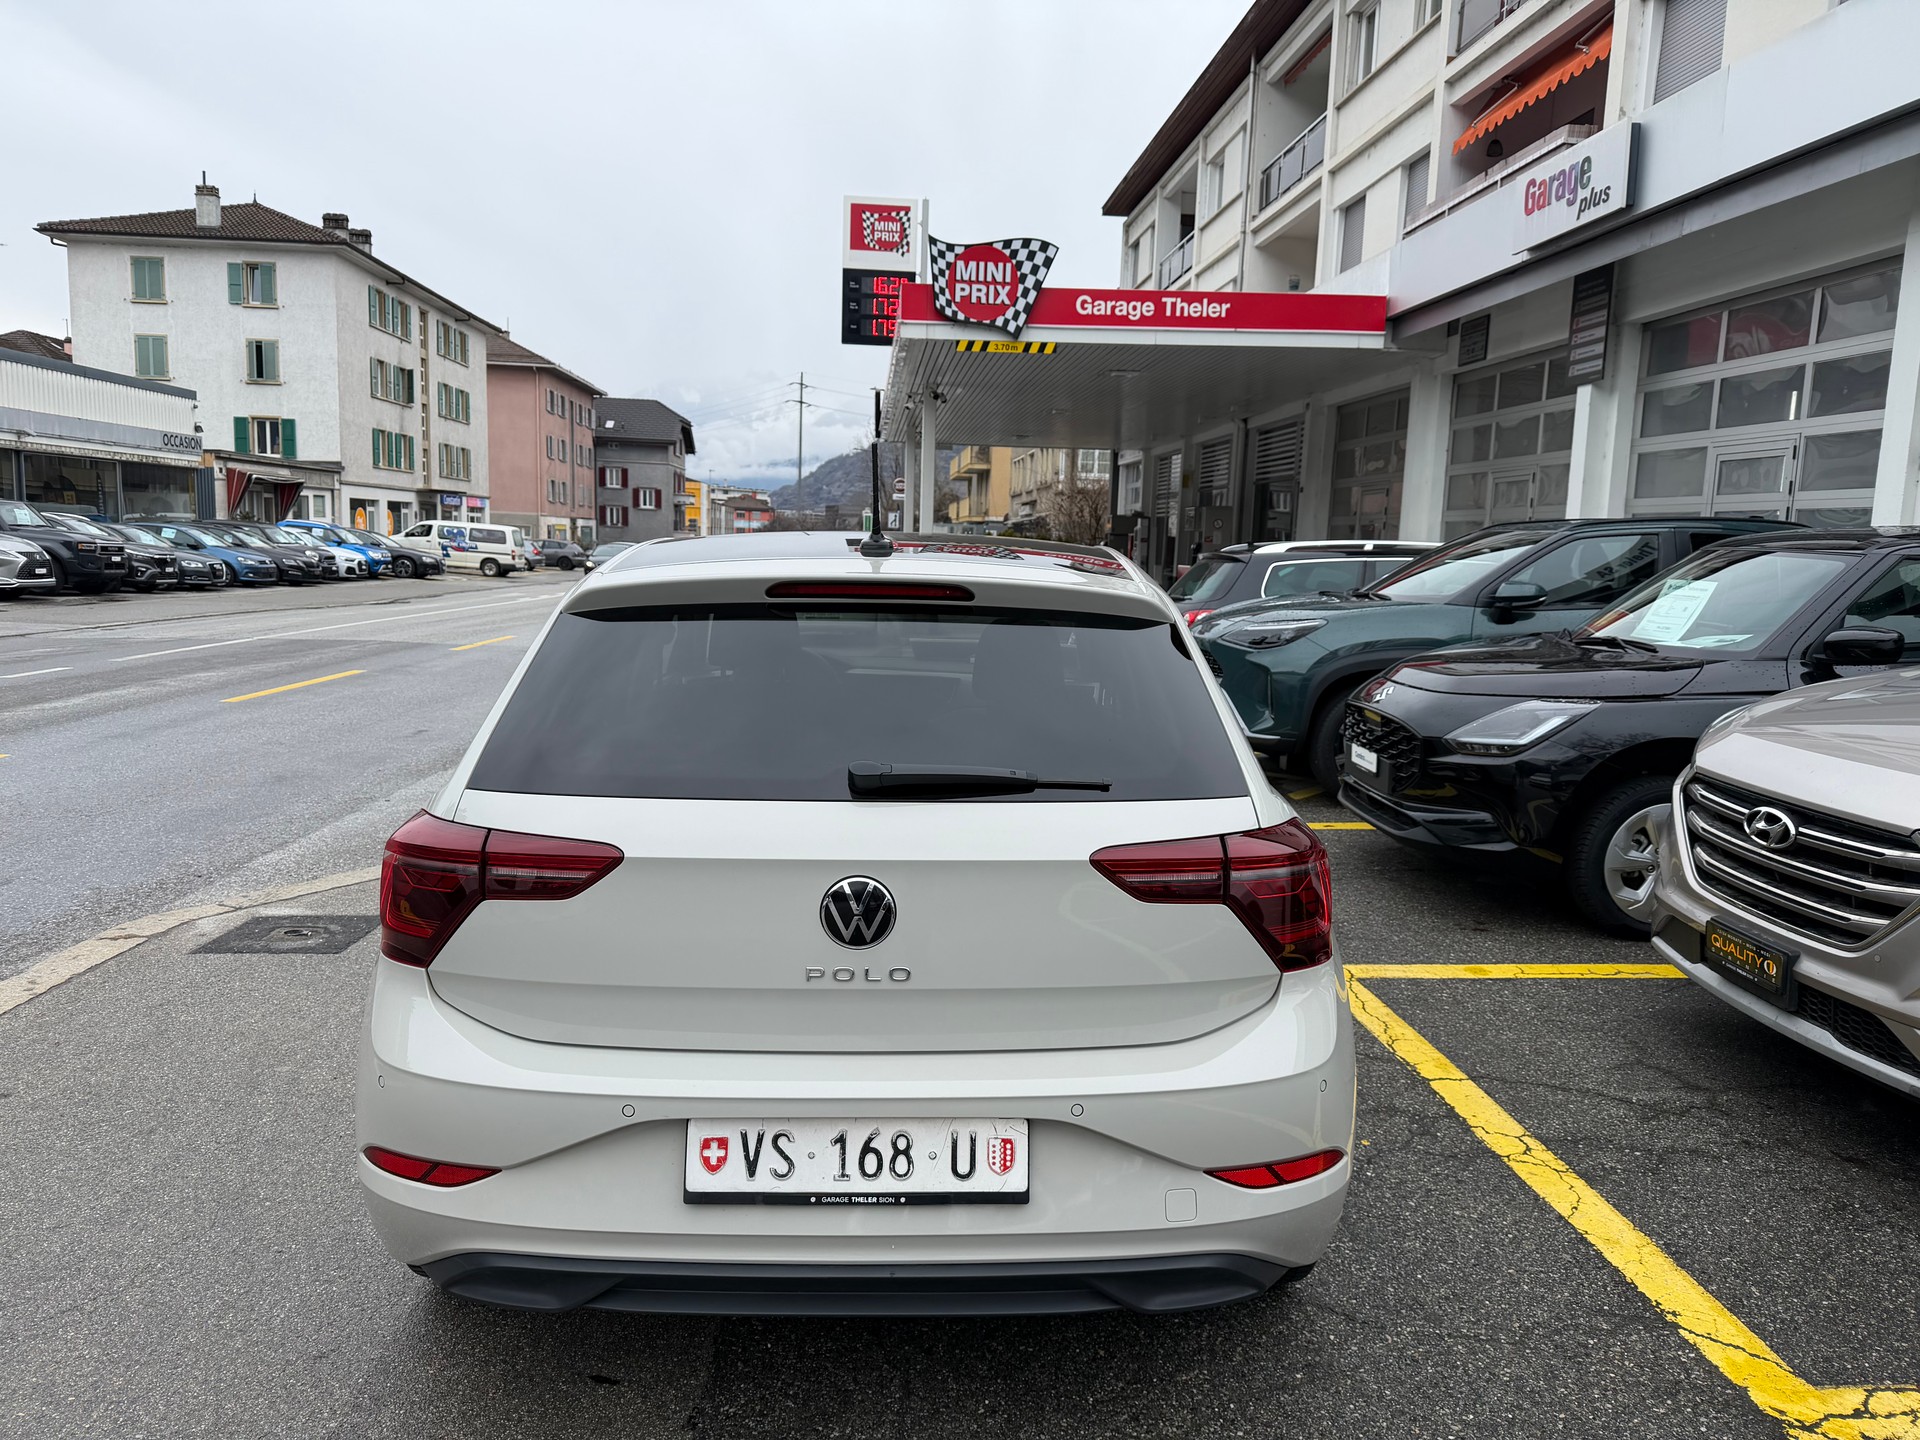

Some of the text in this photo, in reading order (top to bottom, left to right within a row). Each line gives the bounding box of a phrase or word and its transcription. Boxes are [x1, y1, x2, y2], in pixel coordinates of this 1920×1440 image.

[1524, 155, 1592, 216] Garage
[1576, 185, 1611, 221] plus
[873, 231, 900, 242] PRIX
[874, 221, 901, 232] MINI
[955, 260, 1012, 283] MINI
[954, 283, 1012, 305] PRIX
[1075, 294, 1231, 321] Garage Theler
[1711, 933, 1763, 968] QUALITY
[805, 966, 911, 982] POLO
[739, 1127, 977, 1182] VS 168 U
[821, 1196, 895, 1204] GARAGE THELER SION
